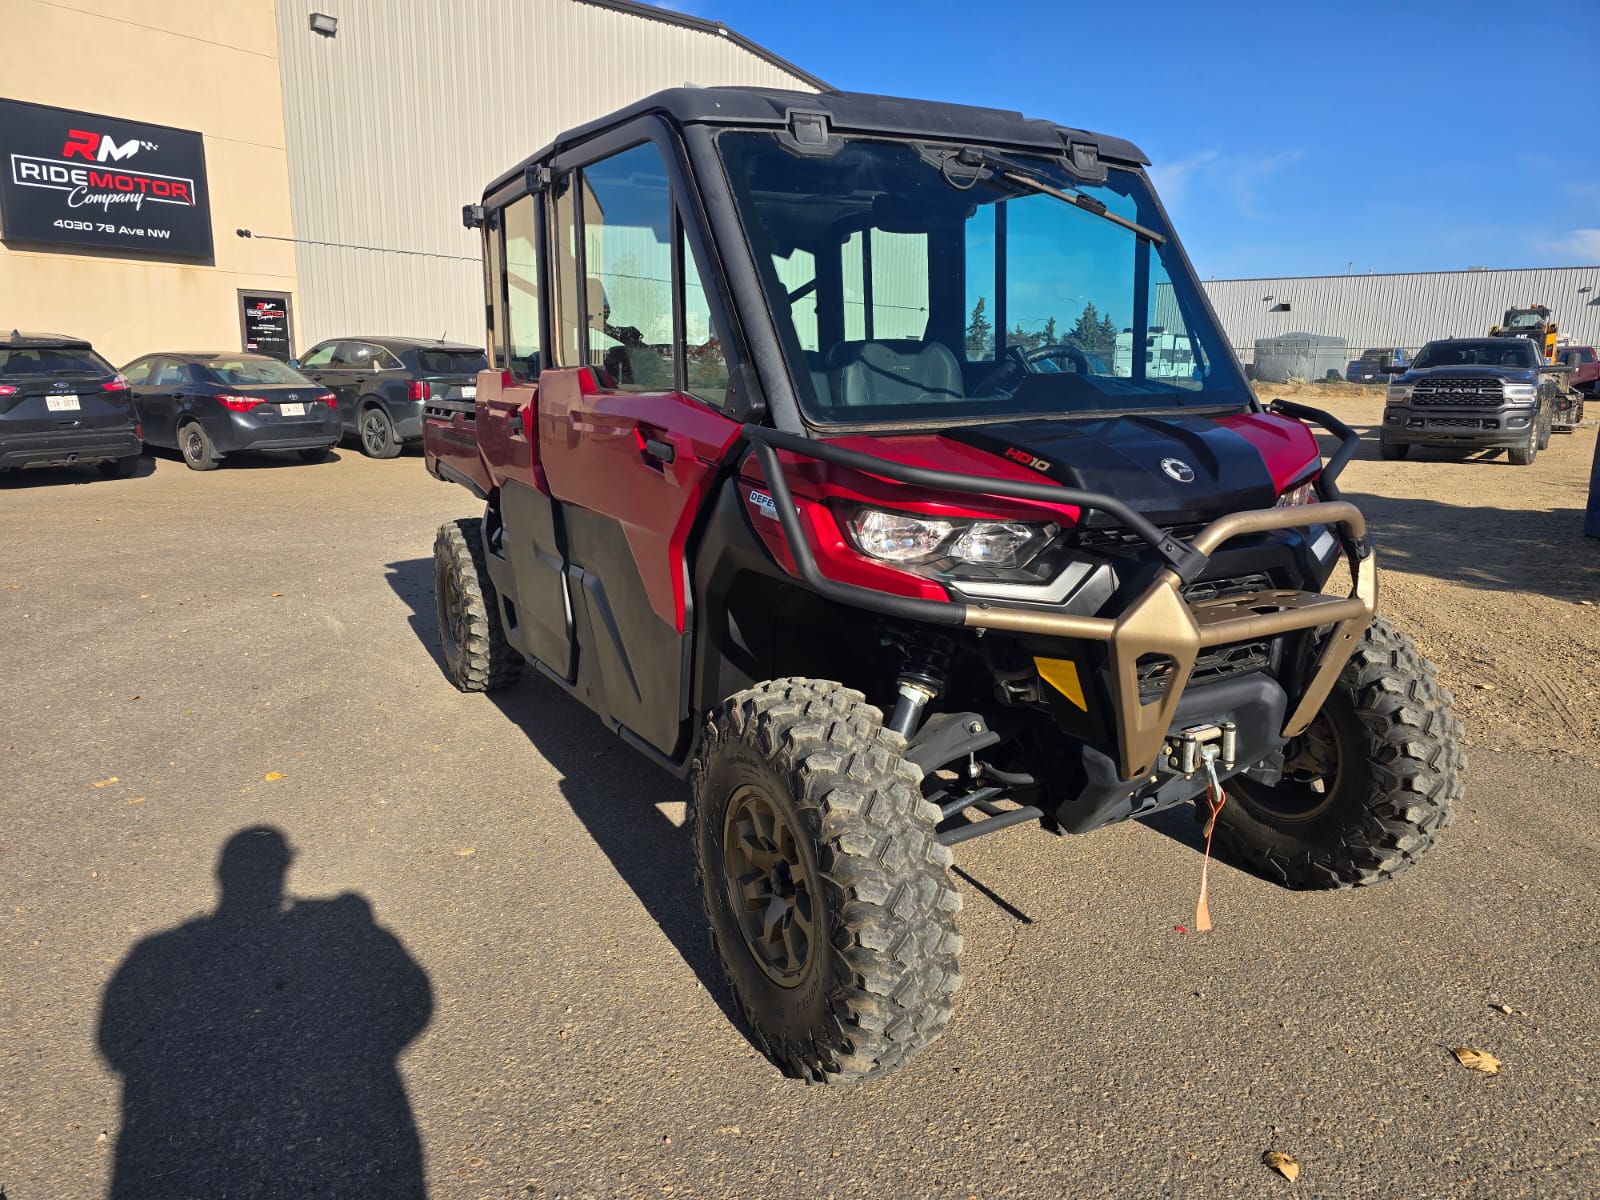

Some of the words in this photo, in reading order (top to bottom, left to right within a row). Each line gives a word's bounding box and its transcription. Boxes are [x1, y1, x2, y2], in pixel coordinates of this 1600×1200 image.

[63, 129, 140, 162] RM
[67, 186, 144, 212] Company
[53, 219, 93, 231] 4030
[96, 223, 115, 233] 78
[119, 226, 144, 236] Ave
[147, 229, 170, 239] NW
[1005, 447, 1051, 471] HD10
[750, 492, 775, 508] DEFE
